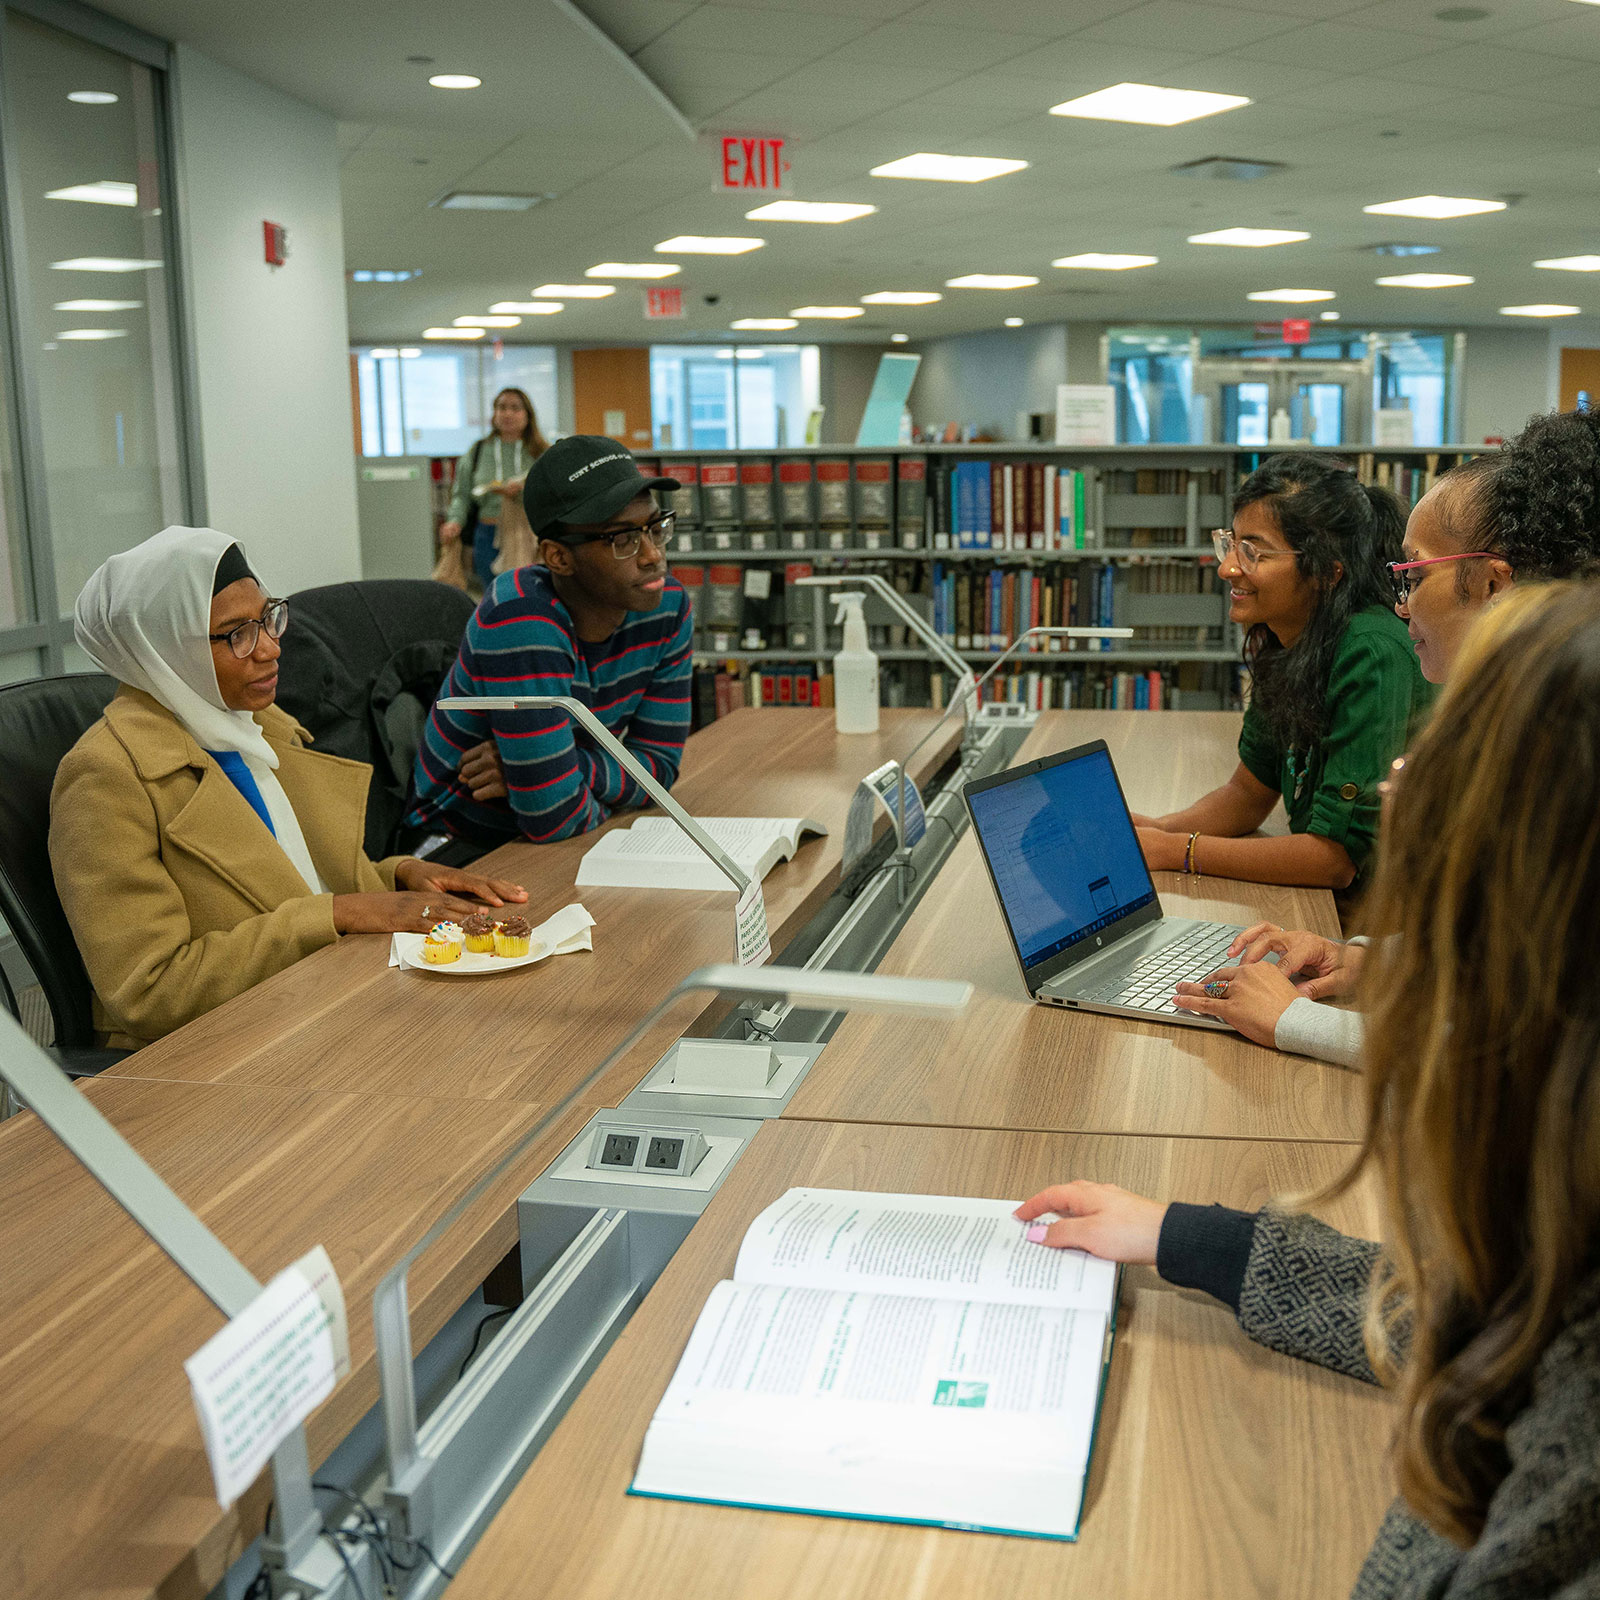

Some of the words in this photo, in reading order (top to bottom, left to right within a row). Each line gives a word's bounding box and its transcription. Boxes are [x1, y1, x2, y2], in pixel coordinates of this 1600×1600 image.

[722, 137, 784, 189] EXIT
[569, 466, 589, 481] CUNY
[590, 454, 618, 469] SCHOOL
